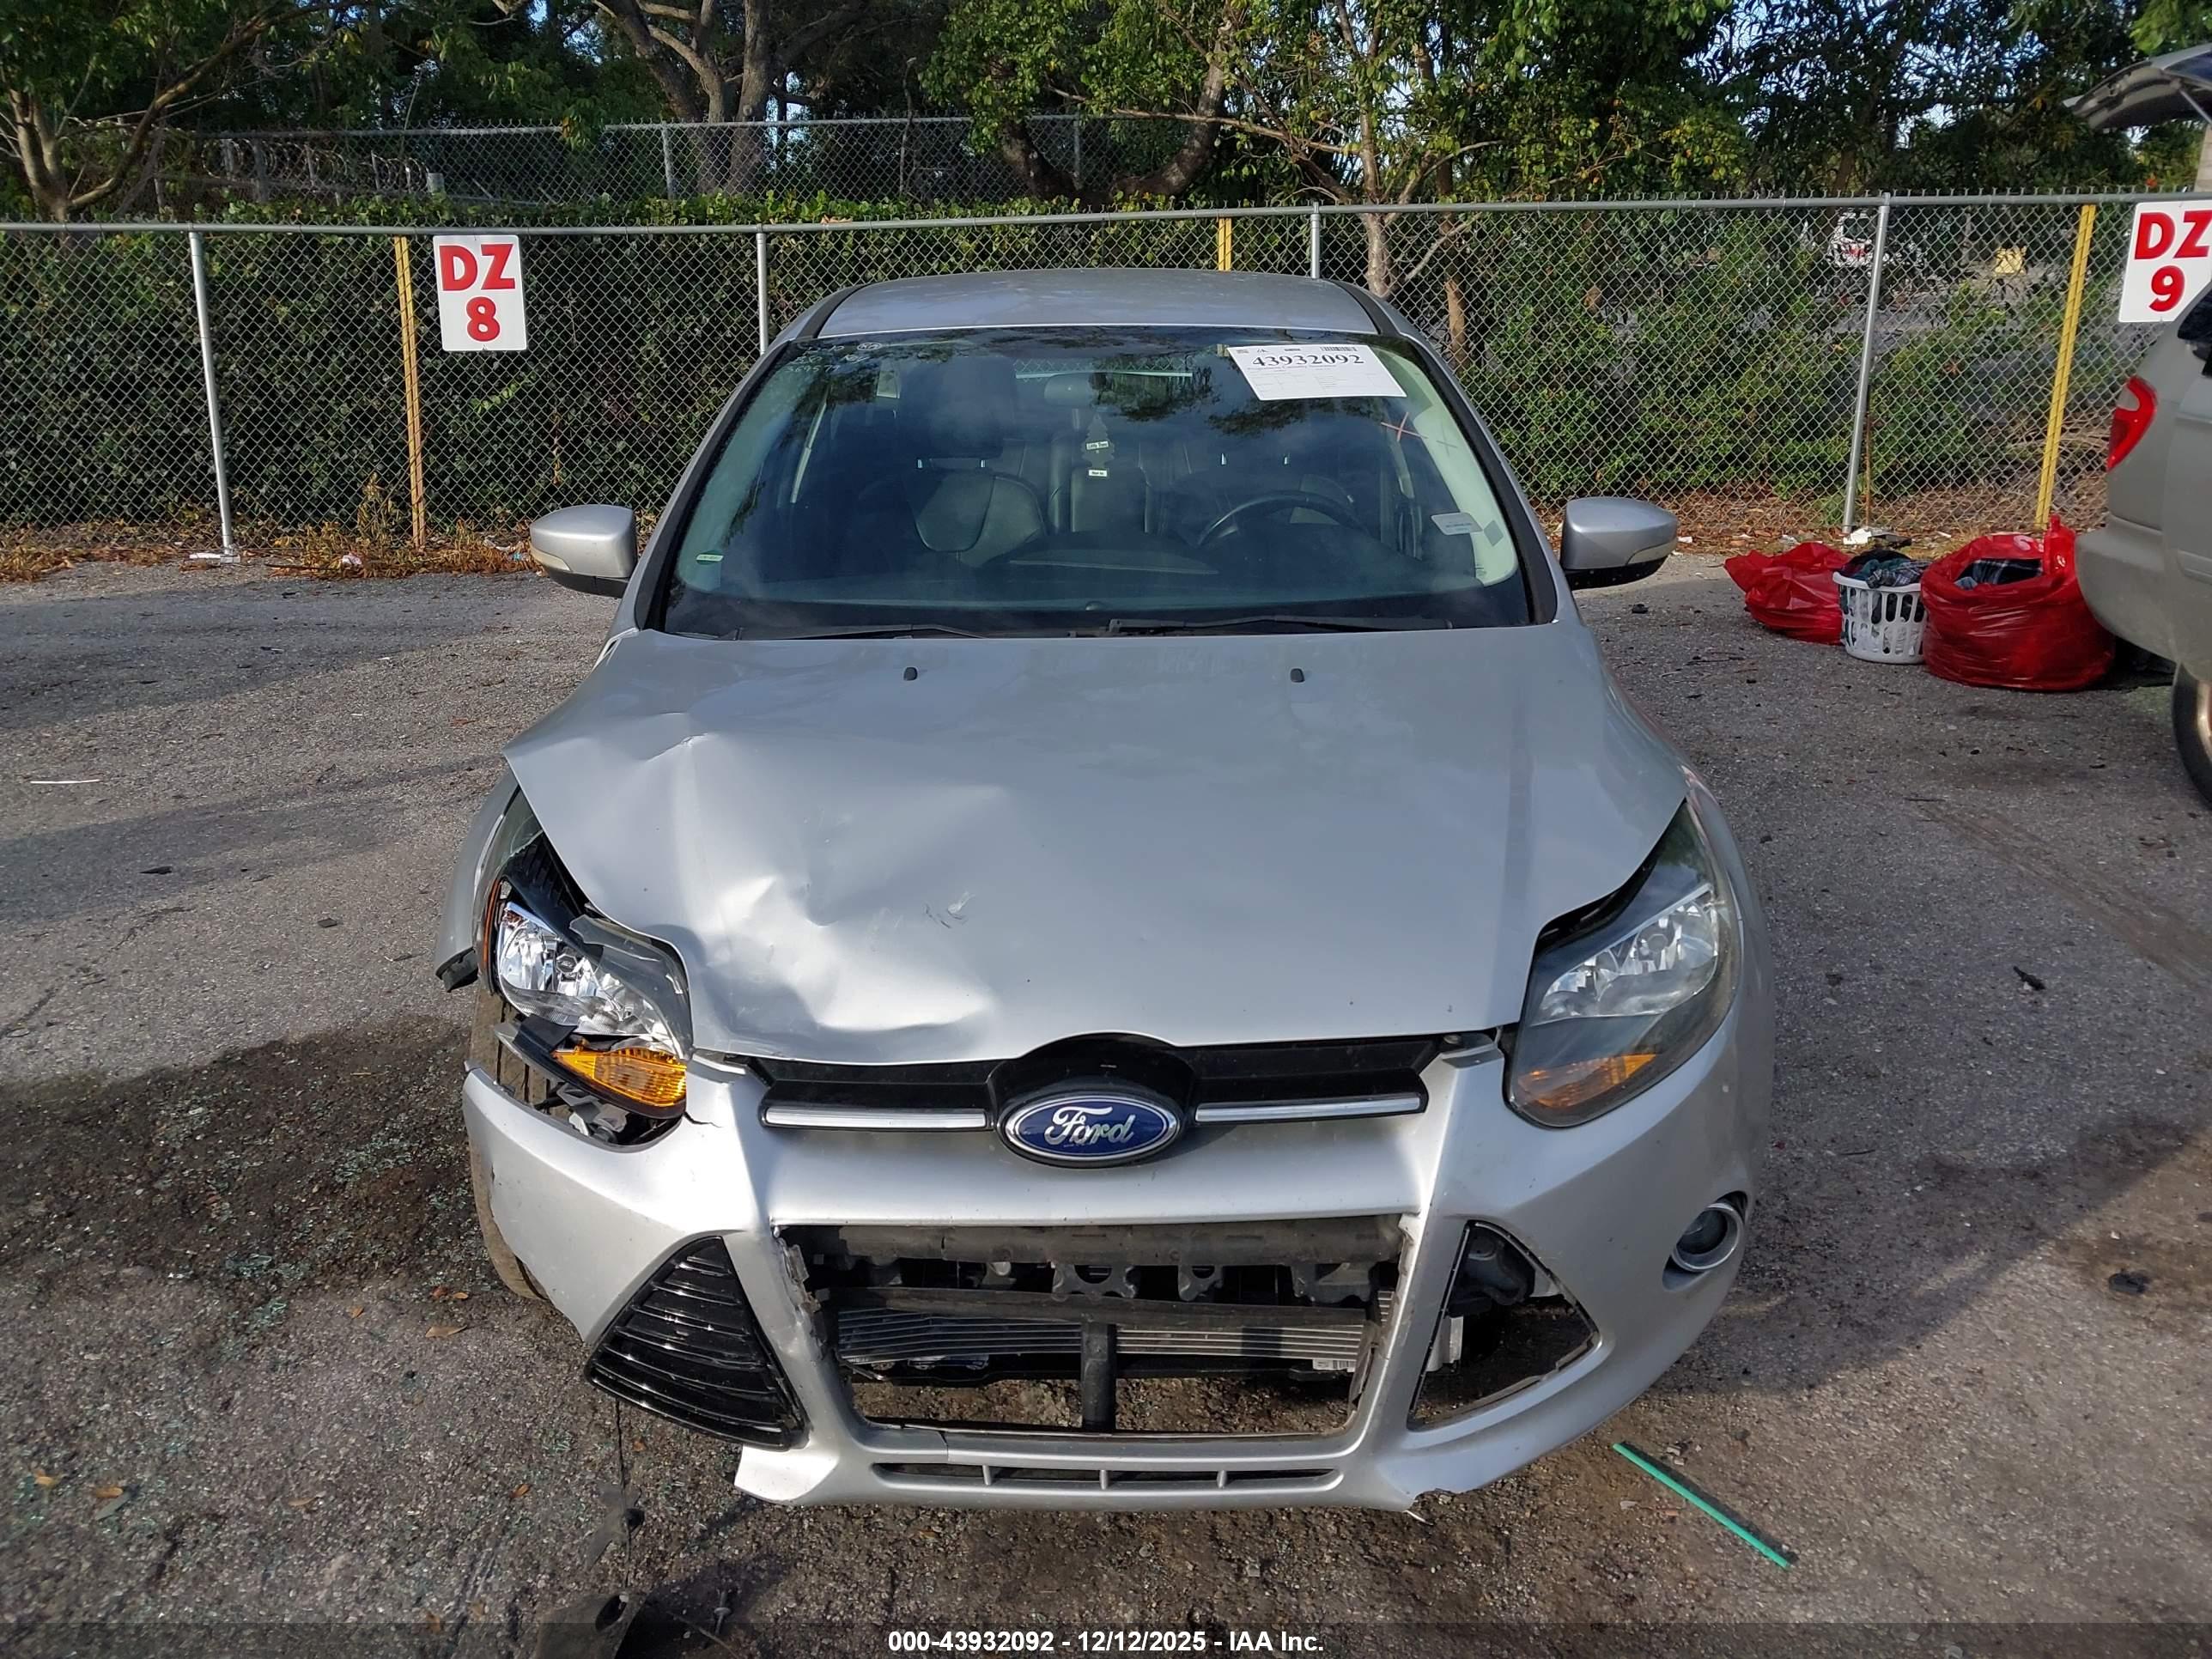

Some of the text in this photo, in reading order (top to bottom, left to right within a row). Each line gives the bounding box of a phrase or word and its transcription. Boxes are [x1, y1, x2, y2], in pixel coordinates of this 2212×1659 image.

[2134, 210, 2212, 260] DZ
[439, 243, 516, 292] DZ
[2148, 264, 2185, 313] 9
[465, 296, 501, 343] 8
[1252, 355, 1364, 367] 43932092
[1044, 1106, 1136, 1146] Ford
